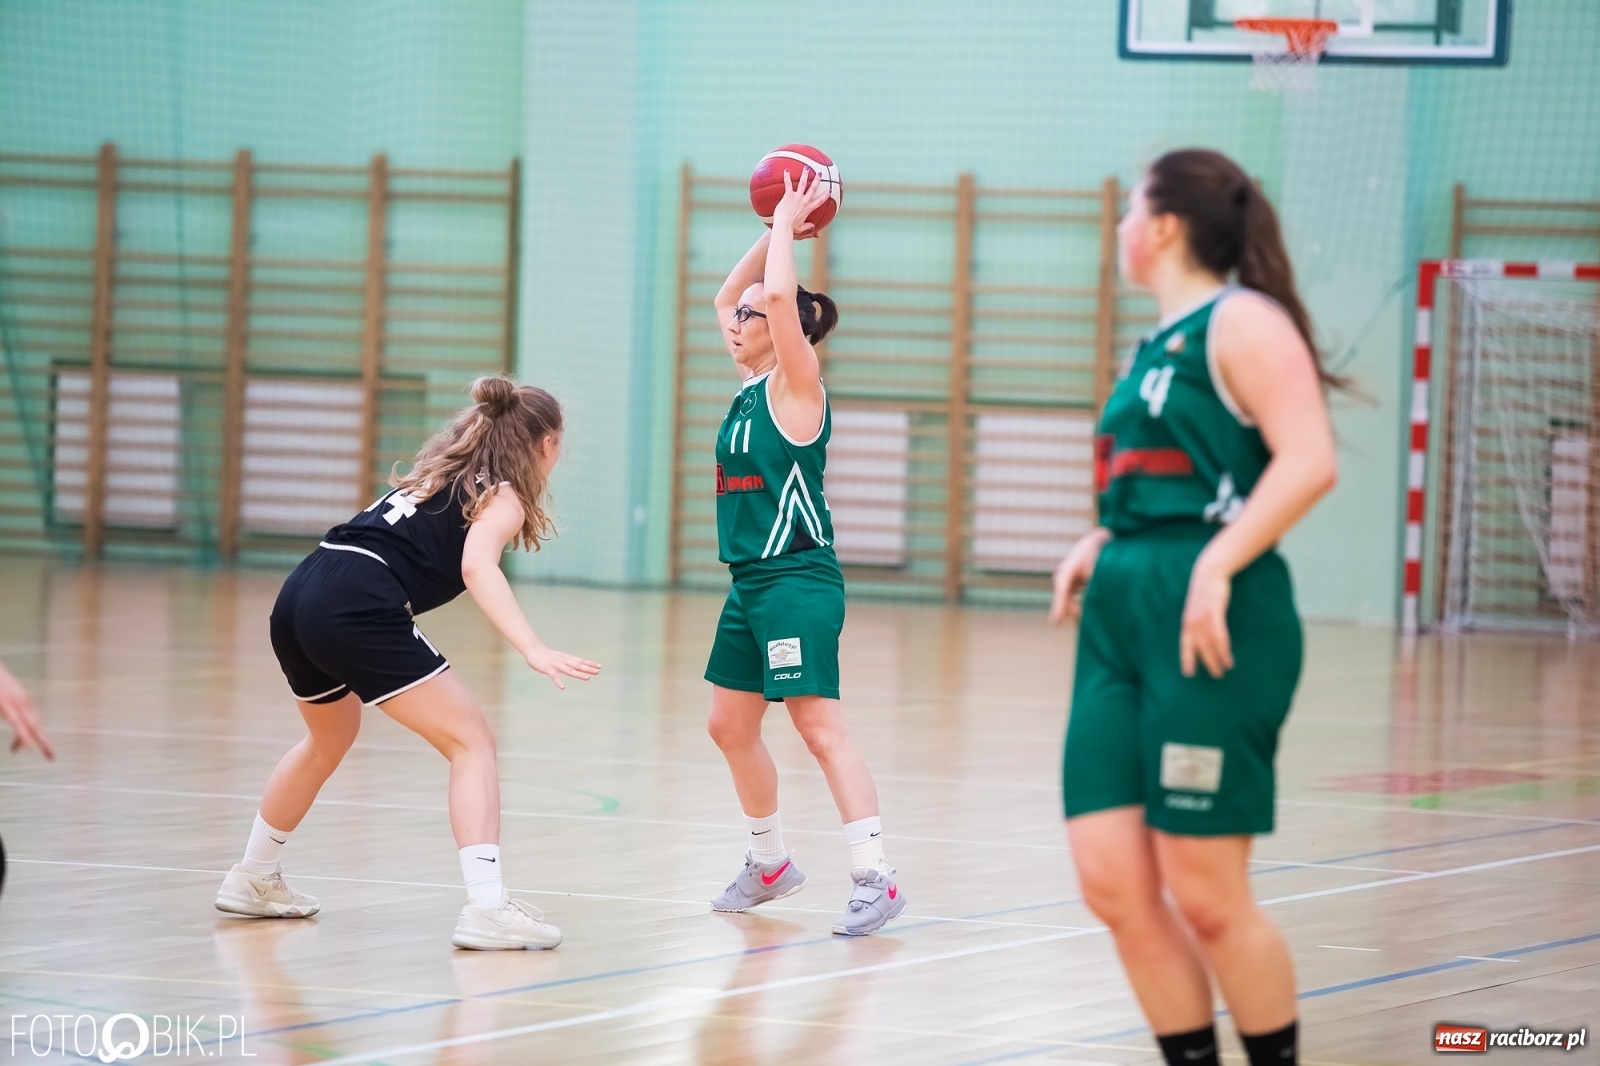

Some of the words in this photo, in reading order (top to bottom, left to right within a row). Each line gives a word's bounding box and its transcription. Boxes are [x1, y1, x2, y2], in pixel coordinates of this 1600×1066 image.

[1139, 364, 1175, 418] 4
[730, 418, 752, 454] 11
[774, 672, 801, 680] COLO
